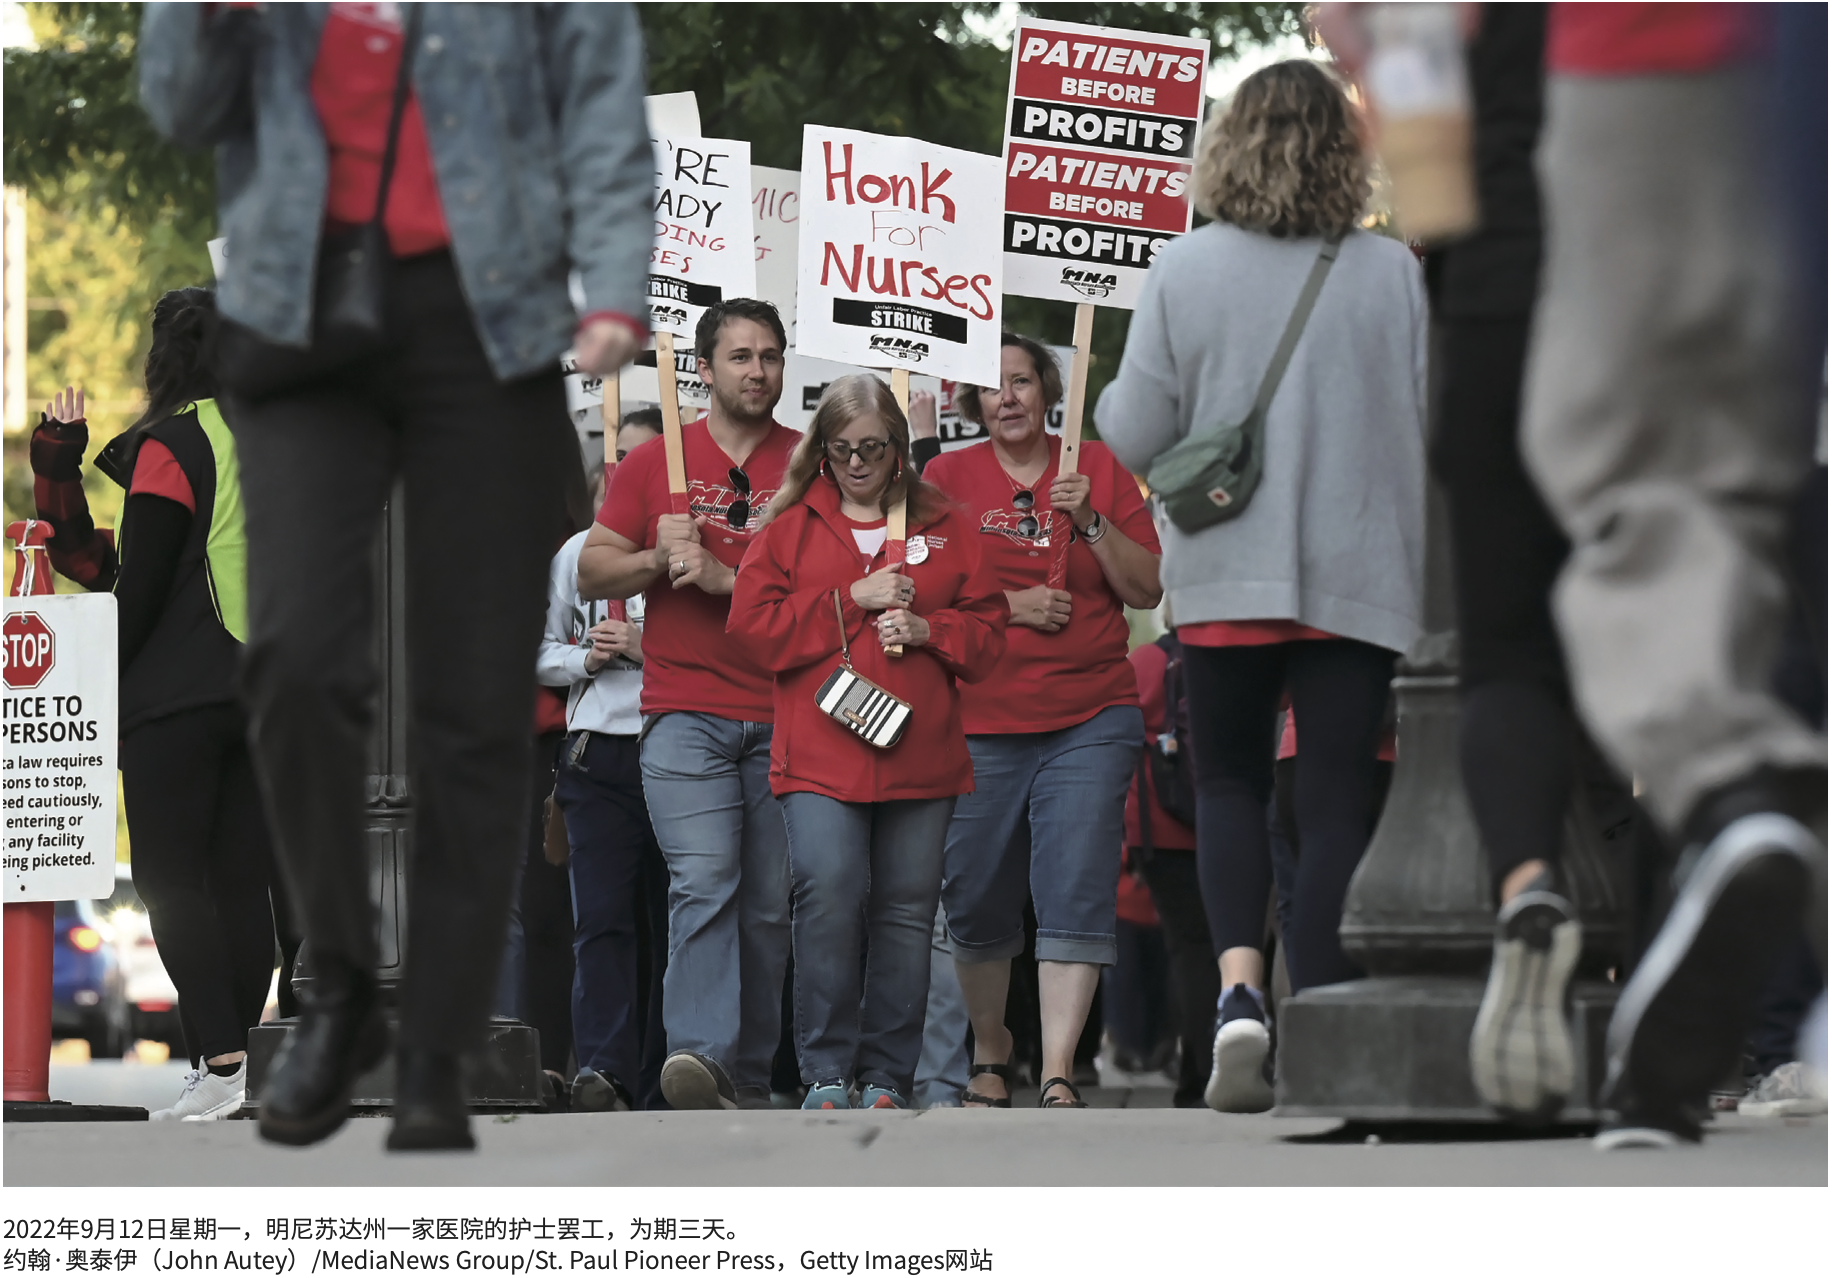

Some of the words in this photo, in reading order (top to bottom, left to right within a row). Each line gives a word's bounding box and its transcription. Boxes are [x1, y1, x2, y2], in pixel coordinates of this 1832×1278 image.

[1021, 37, 1202, 83] PATIENTS
[1061, 77, 1156, 106] BEFORE
[1023, 106, 1184, 152] PROFITS
[652, 138, 730, 189] 'RE
[1009, 151, 1192, 198] PATIENTS
[823, 141, 956, 224] Honk
[655, 186, 723, 228] ADY
[1049, 192, 1144, 221] BEFORE
[871, 210, 947, 251] For
[1012, 221, 1172, 264] PROFITS
[820, 241, 994, 321] Nurses
[1063, 269, 1117, 286] MNA
[871, 310, 933, 334] STRIKE
[911, 308, 933, 317] Practice
[871, 336, 929, 354] MNA
[673, 353, 696, 372] TR
[3, 697, 46, 719] TICE
[53, 695, 82, 717] TO
[18, 755, 43, 769] law
[46, 753, 103, 771] requires
[3, 777, 31, 789] sons
[35, 776, 49, 788] to
[53, 775, 87, 790] stop,
[27, 792, 102, 810] cautiously,
[6, 814, 65, 831] entering
[68, 815, 83, 826] or
[8, 837, 34, 851] any
[37, 833, 84, 850] facility
[32, 852, 95, 871] picketed.
